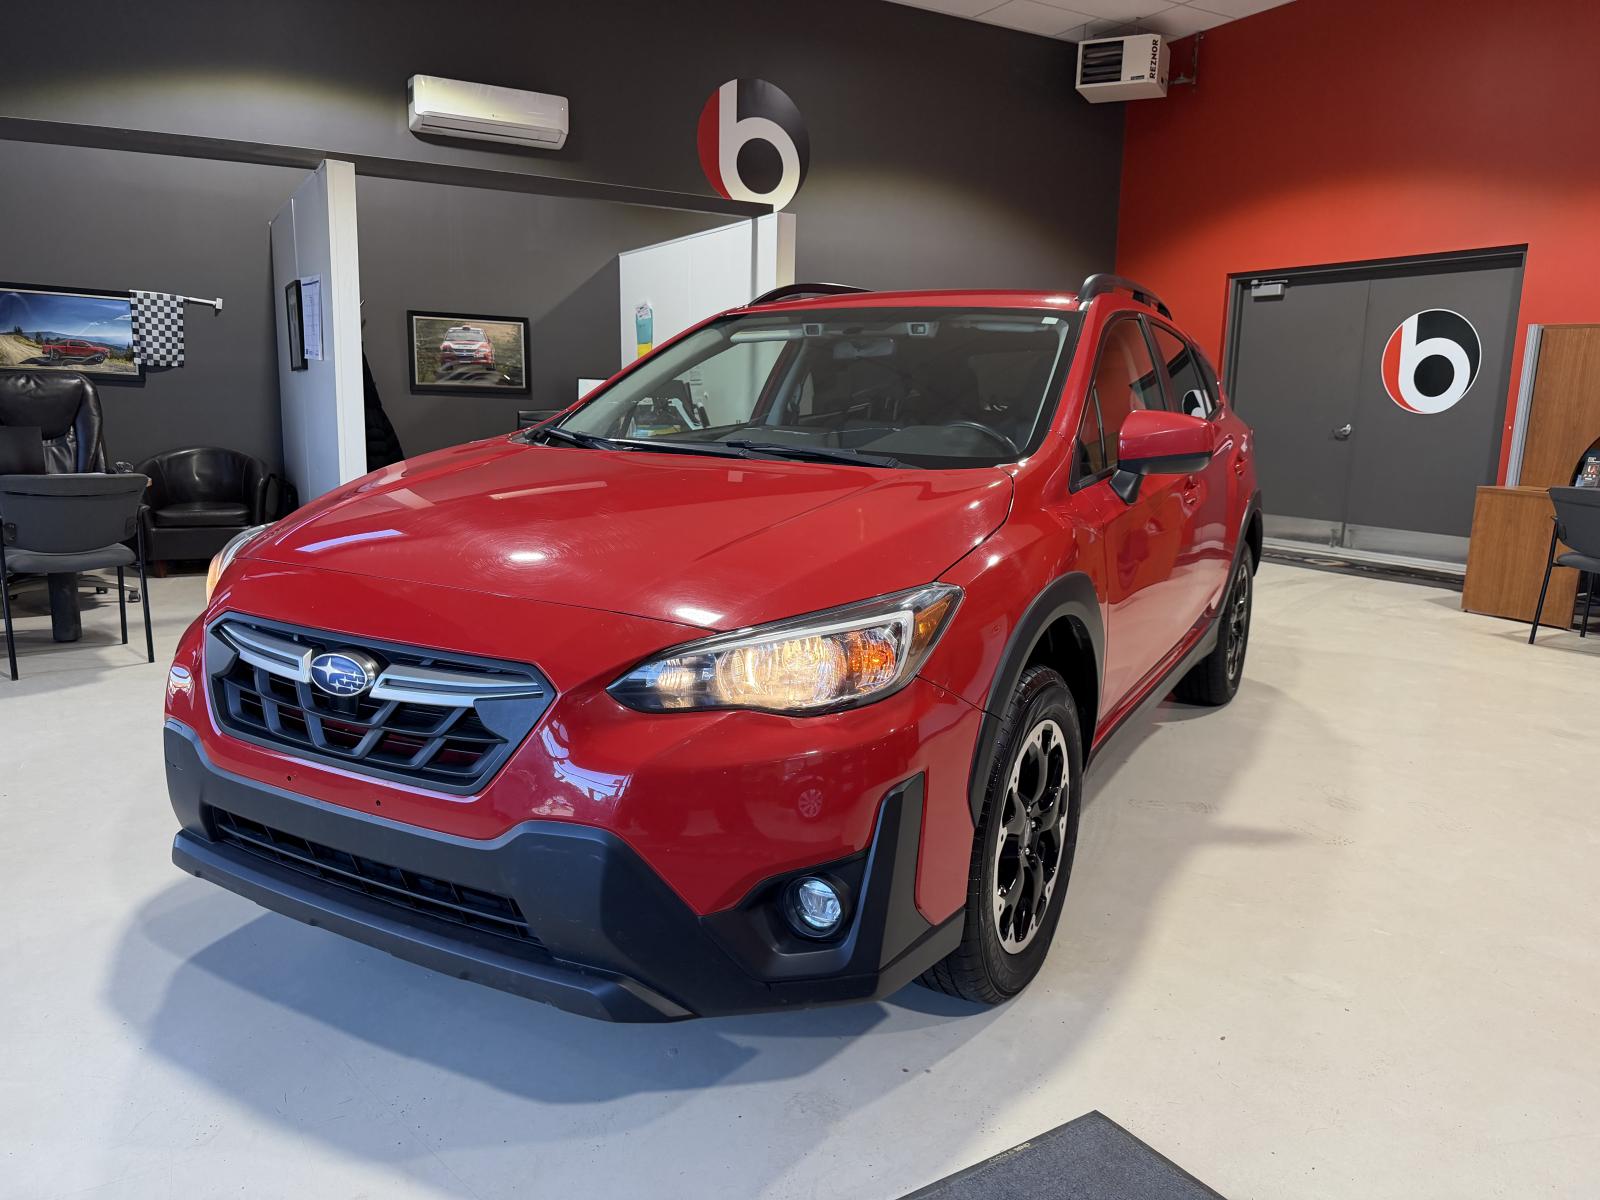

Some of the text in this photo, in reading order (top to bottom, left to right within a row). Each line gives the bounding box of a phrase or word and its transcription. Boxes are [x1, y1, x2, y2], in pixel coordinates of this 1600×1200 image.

[1149, 39, 1159, 79] REZNOR
[719, 79, 800, 212] b
[1398, 313, 1470, 414] b
